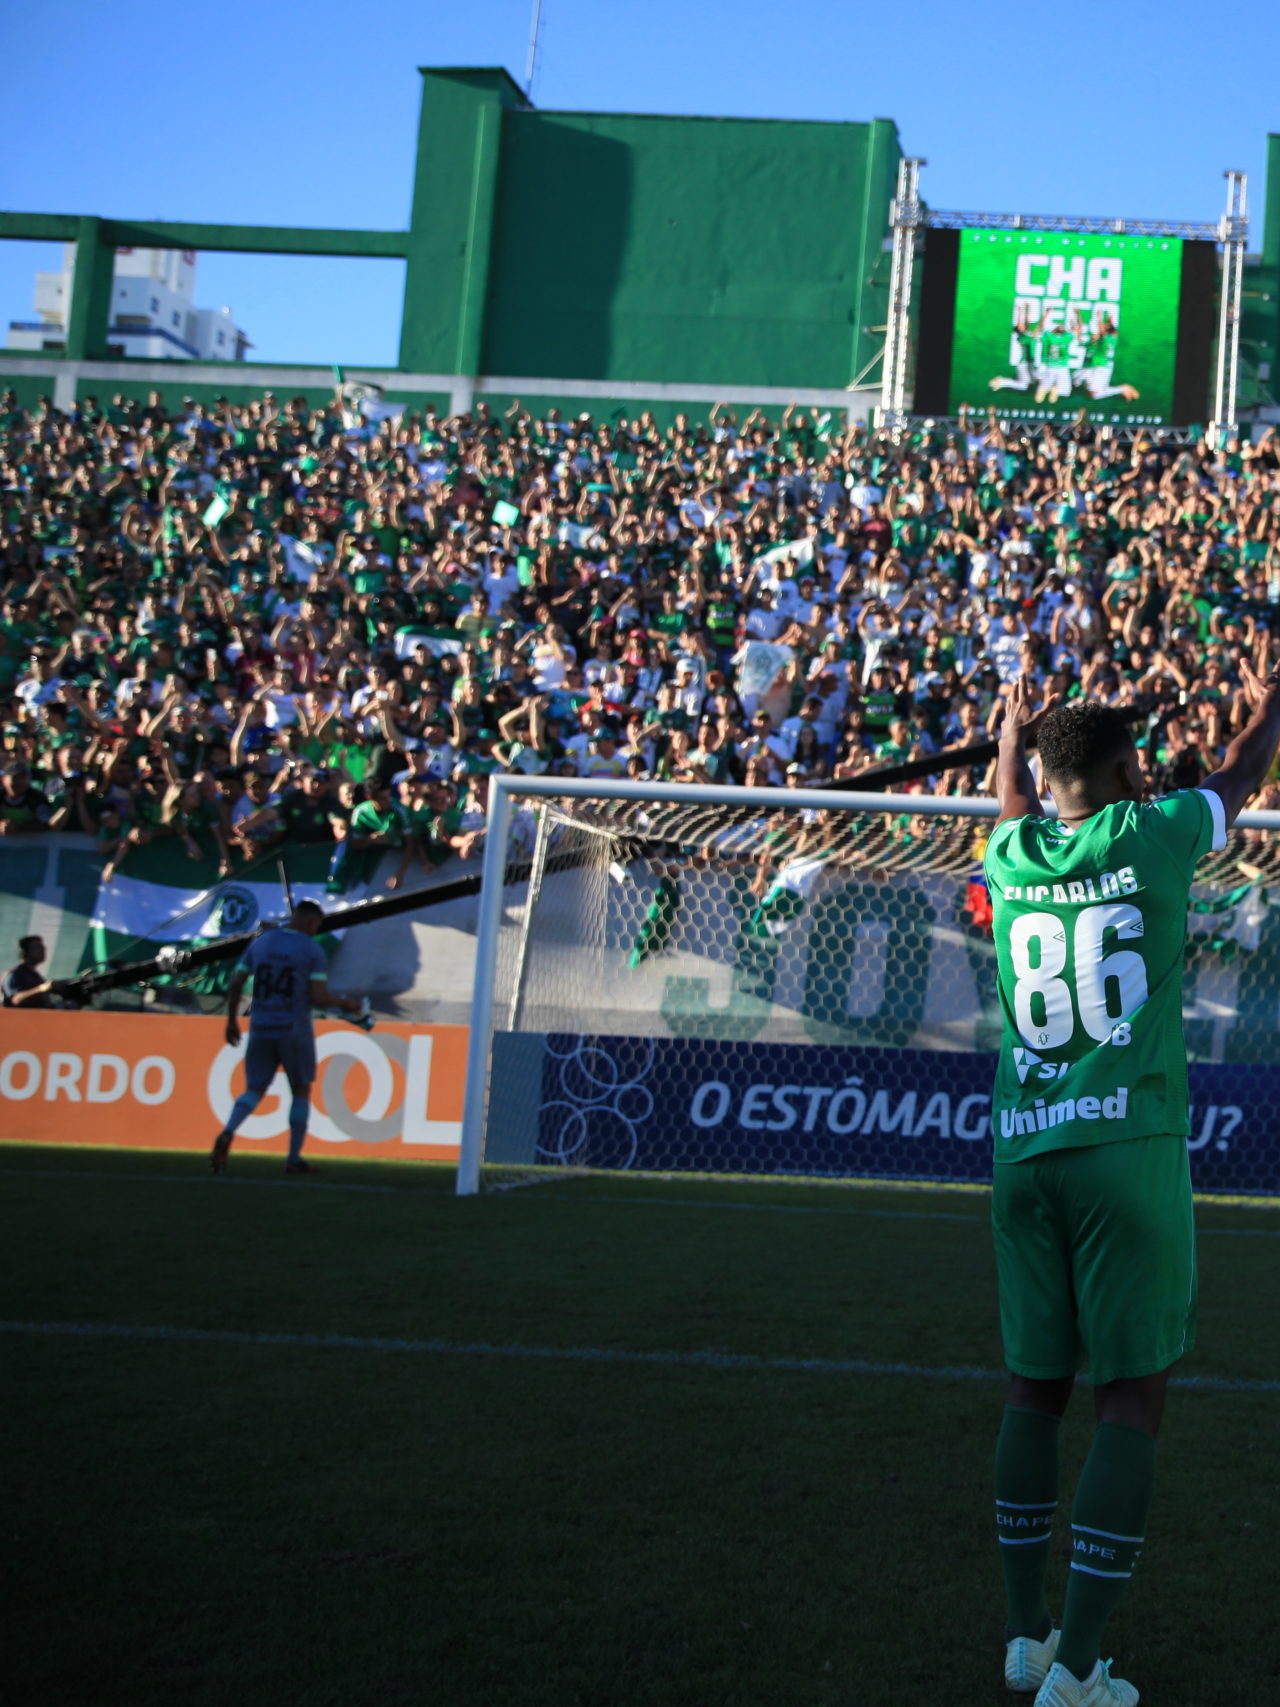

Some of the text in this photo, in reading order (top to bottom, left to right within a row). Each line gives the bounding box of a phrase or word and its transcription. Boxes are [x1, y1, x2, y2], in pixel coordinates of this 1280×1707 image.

[1015, 254, 1122, 301] CHA
[1010, 904, 1149, 1050] 86
[0, 1051, 176, 1105] ORDO
[207, 1030, 463, 1145] GOL
[690, 1080, 732, 1128] O
[739, 1076, 995, 1141] ESTÔMAG
[1000, 1087, 1128, 1139] Unimed
